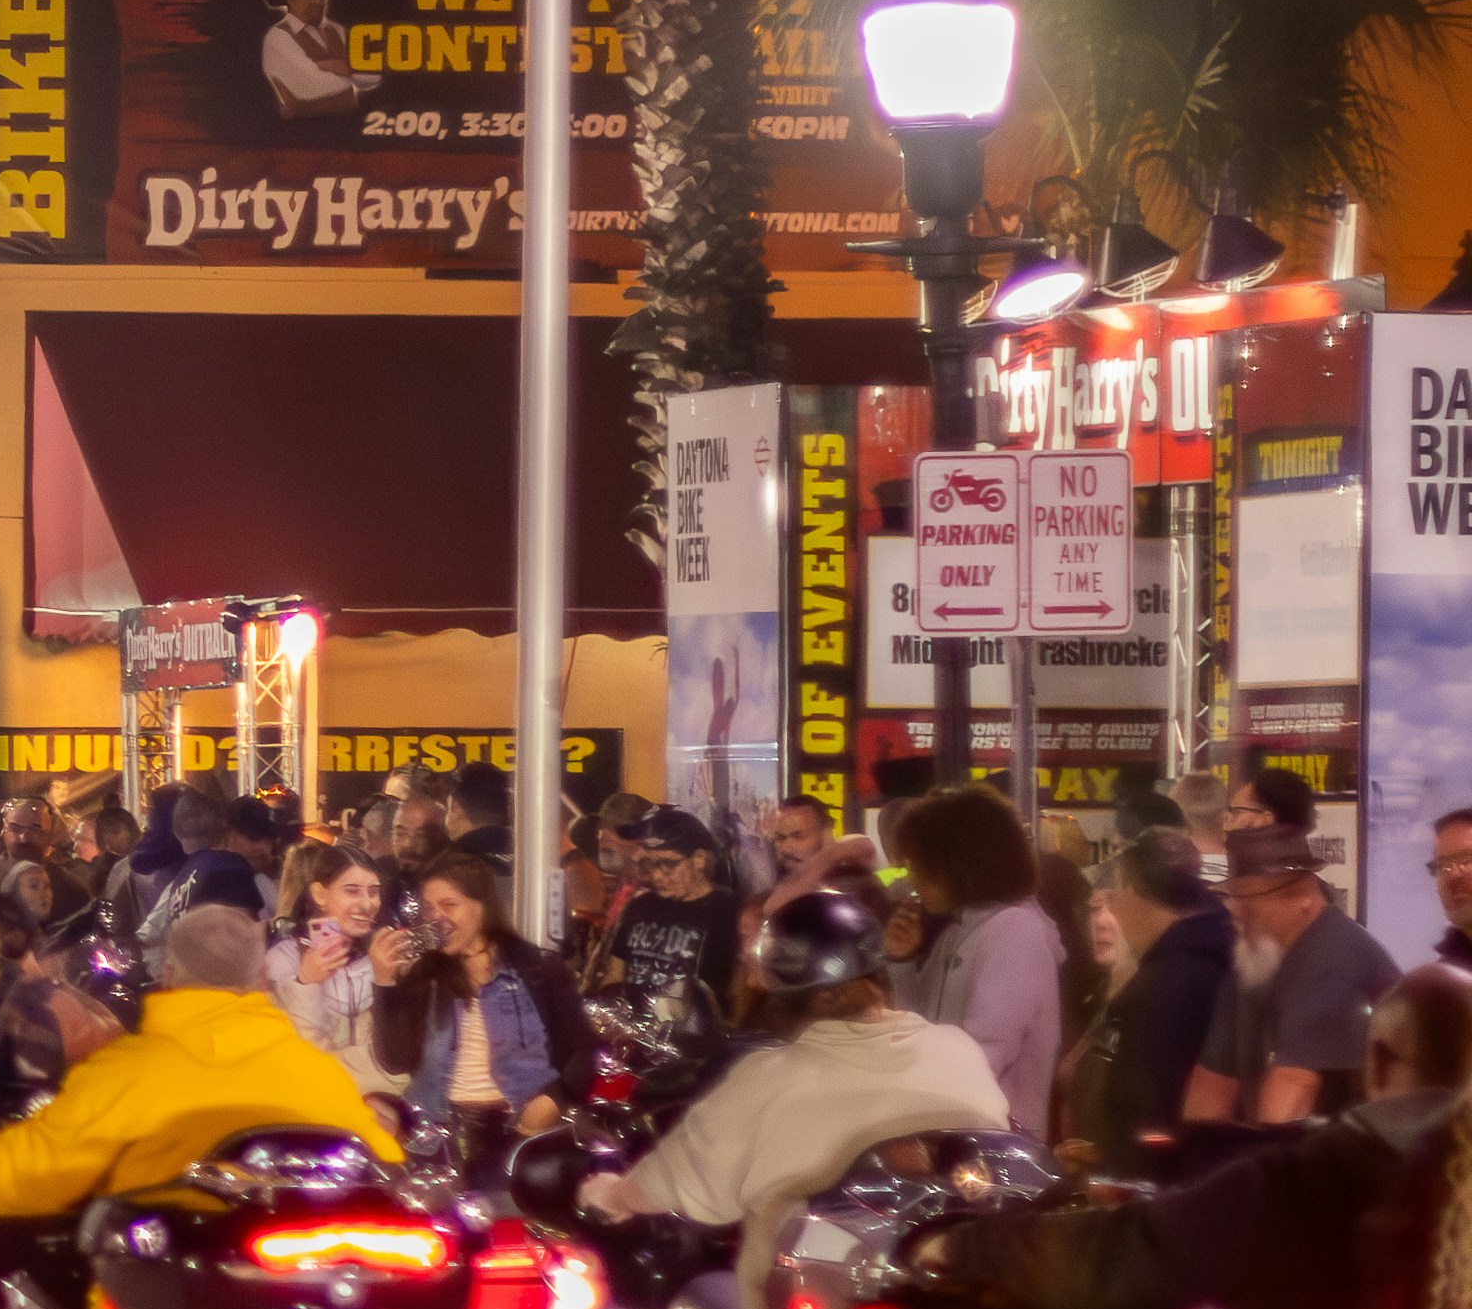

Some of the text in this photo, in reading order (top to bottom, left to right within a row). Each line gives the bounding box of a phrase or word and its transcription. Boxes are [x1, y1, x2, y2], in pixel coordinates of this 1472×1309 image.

[349, 24, 629, 73] CONTST
[675, 436, 730, 486] DAYTONA
[1059, 465, 1097, 497] NO
[1258, 436, 1343, 481] TONIGHT
[675, 488, 704, 534] BIKE
[1034, 505, 1124, 537] PARKING
[801, 433, 846, 666] EVENTS
[920, 524, 1016, 546] PARKING
[1059, 543, 1098, 564] ANY
[675, 536, 711, 583] WEEK
[940, 565, 996, 587] ONLY
[1053, 571, 1104, 594] TIME
[801, 682, 846, 756] OF
